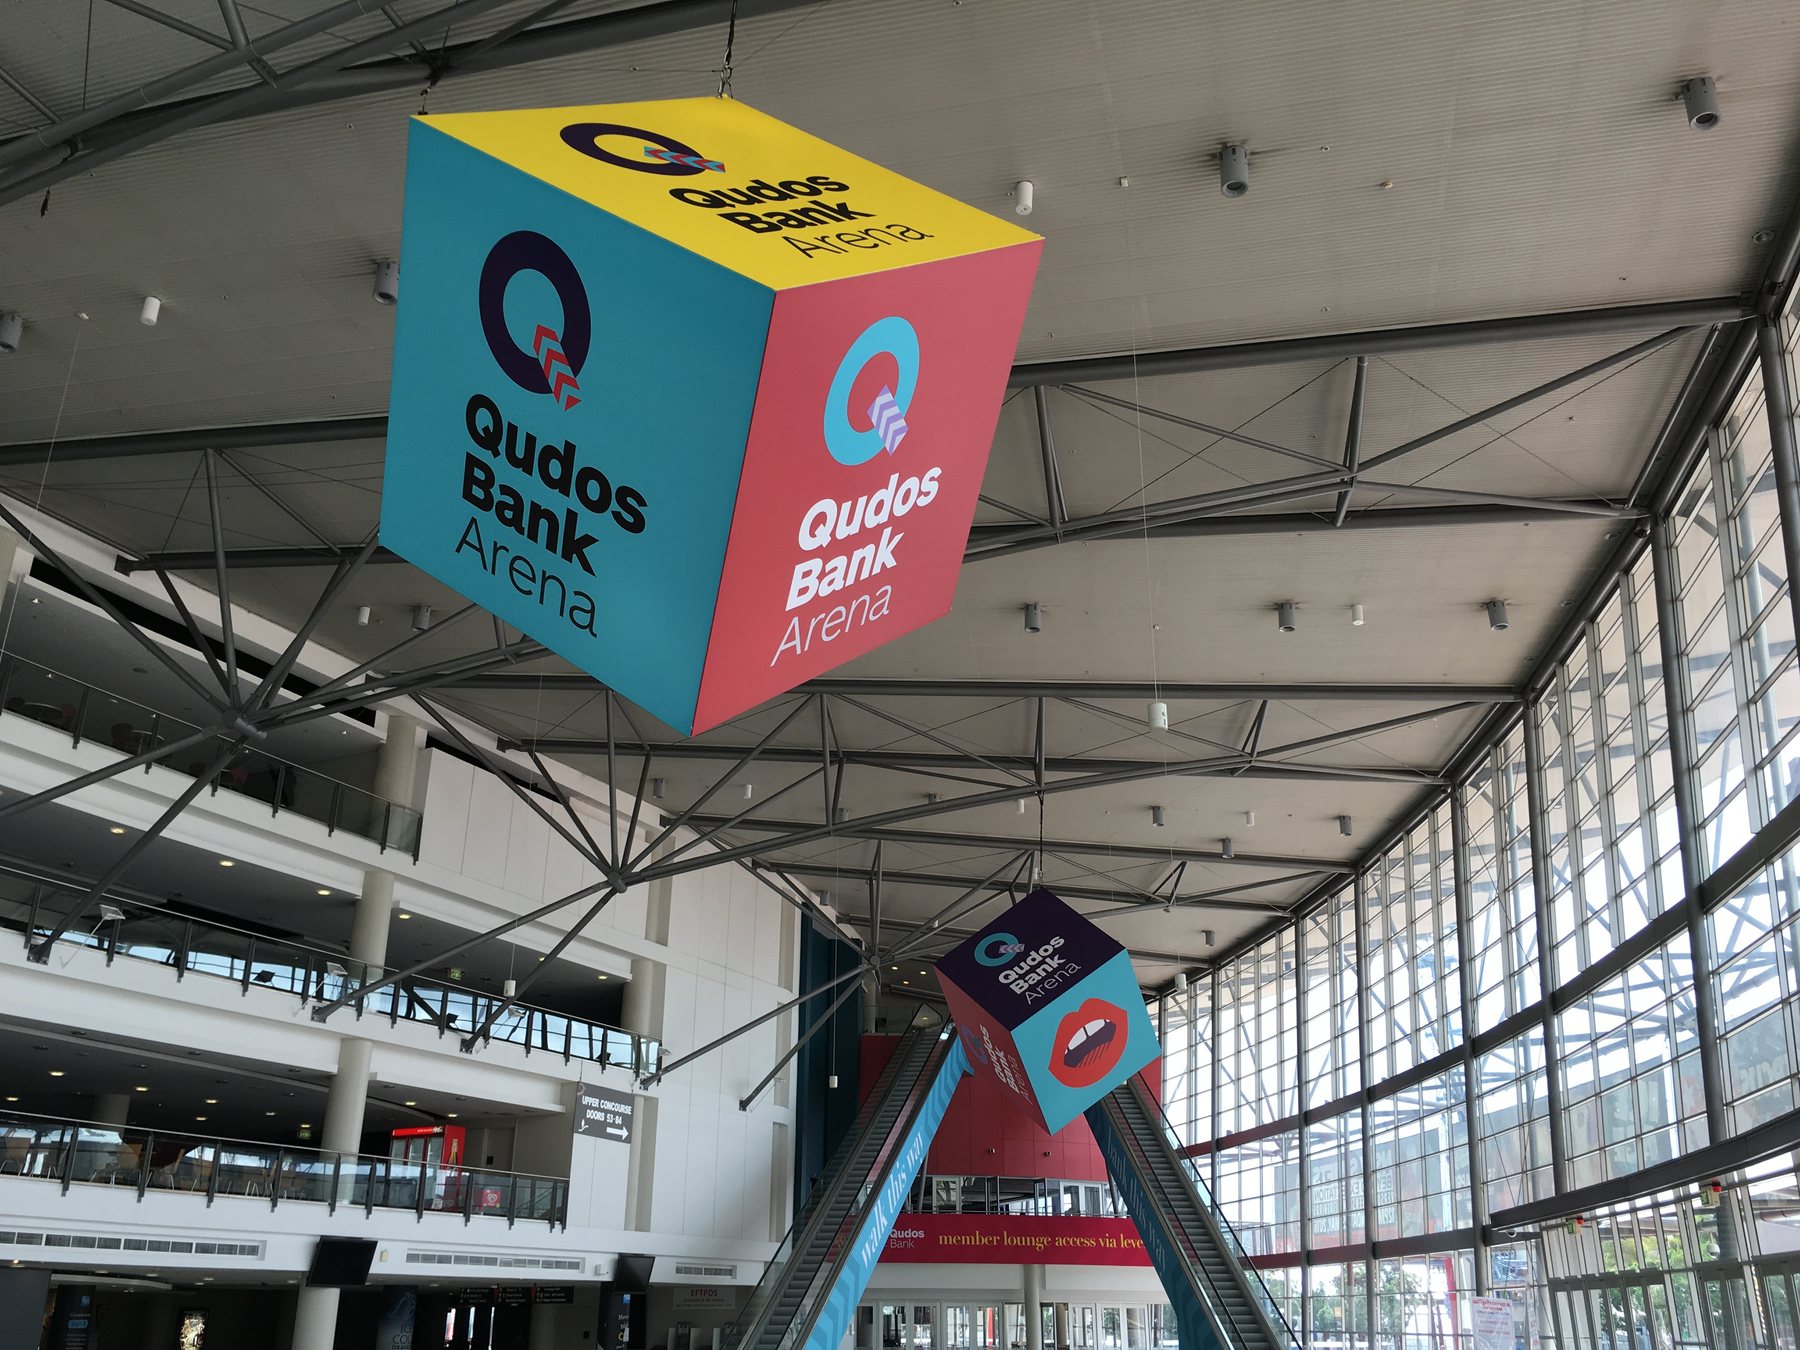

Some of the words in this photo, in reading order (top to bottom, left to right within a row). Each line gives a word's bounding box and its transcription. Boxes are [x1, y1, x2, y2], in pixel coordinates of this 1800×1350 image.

[668, 175, 850, 209] Qudos
[716, 200, 877, 234] Bank
[781, 223, 935, 258] Arena
[465, 394, 648, 535] Qudos
[462, 451, 600, 578] Bank
[798, 466, 943, 551] Qudos
[454, 516, 598, 638] Arena
[785, 526, 905, 612] Bank
[770, 585, 892, 668] Arena
[998, 936, 1065, 984] Qudos
[1009, 954, 1066, 995] Bank
[1025, 962, 1082, 1005] Arena
[581, 1095, 600, 1108] UPPER
[600, 1100, 633, 1115] CONCOURSE
[586, 1109, 605, 1121] DOORS
[606, 1113, 622, 1125] 53-84
[861, 1199, 888, 1269] walk
[887, 1161, 907, 1214] this
[906, 1131, 924, 1165] way
[890, 1229, 925, 1239] Qudos
[890, 1239, 915, 1249] Bank
[939, 1230, 1000, 1245] member
[1003, 1231, 1052, 1252] lounge
[1055, 1236, 1097, 1247] access
[1099, 1233, 1117, 1249] via
[1120, 1233, 1146, 1249] leve
[690, 1288, 718, 1297] EFTPOS
